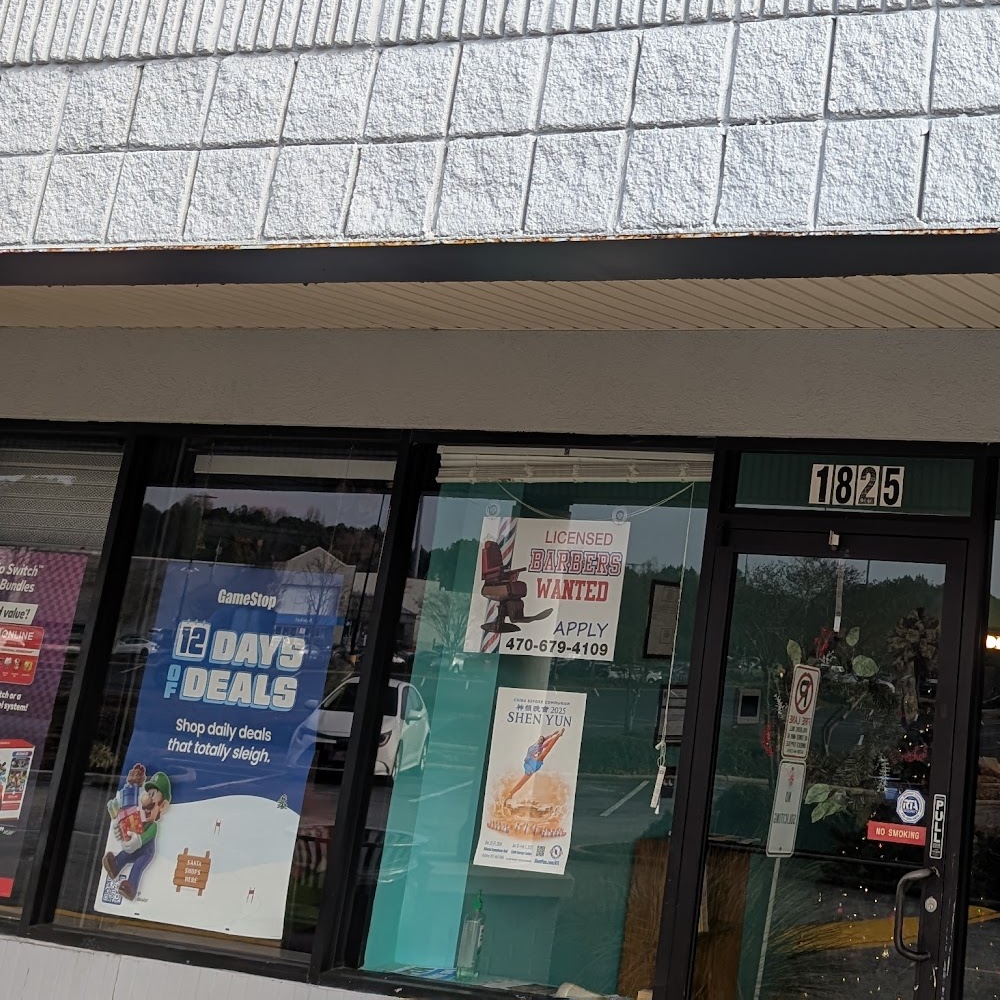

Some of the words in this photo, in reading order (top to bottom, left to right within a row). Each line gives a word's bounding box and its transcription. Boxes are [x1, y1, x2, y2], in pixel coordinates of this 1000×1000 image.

[817, 466, 900, 505] 1825
[545, 530, 613, 546] LICENSED
[528, 549, 623, 576] BARBERS
[0, 579, 35, 593] Bundles
[536, 577, 610, 602] WANTED
[218, 588, 277, 610] GameStop
[2, 629, 34, 641] ONLINE
[553, 621, 609, 639] APPLY
[179, 626, 207, 655] 12
[209, 630, 306, 671] DAYS
[505, 637, 608, 656] 470-679-4109
[163, 664, 182, 698] OF
[179, 667, 298, 712] DEALS
[507, 711, 542, 725] SHEN
[546, 714, 572, 727] YUN
[550, 706, 566, 715] 2025
[176, 718, 205, 737] Shop
[207, 722, 237, 741] daily
[239, 725, 272, 741] deals
[167, 738, 192, 753] that
[194, 741, 232, 761] totally
[232, 745, 271, 766] sleigh.
[933, 799, 944, 843] PULL
[875, 827, 886, 836] NO
[888, 829, 920, 840] SMOKING
[187, 859, 202, 867] SANTA
